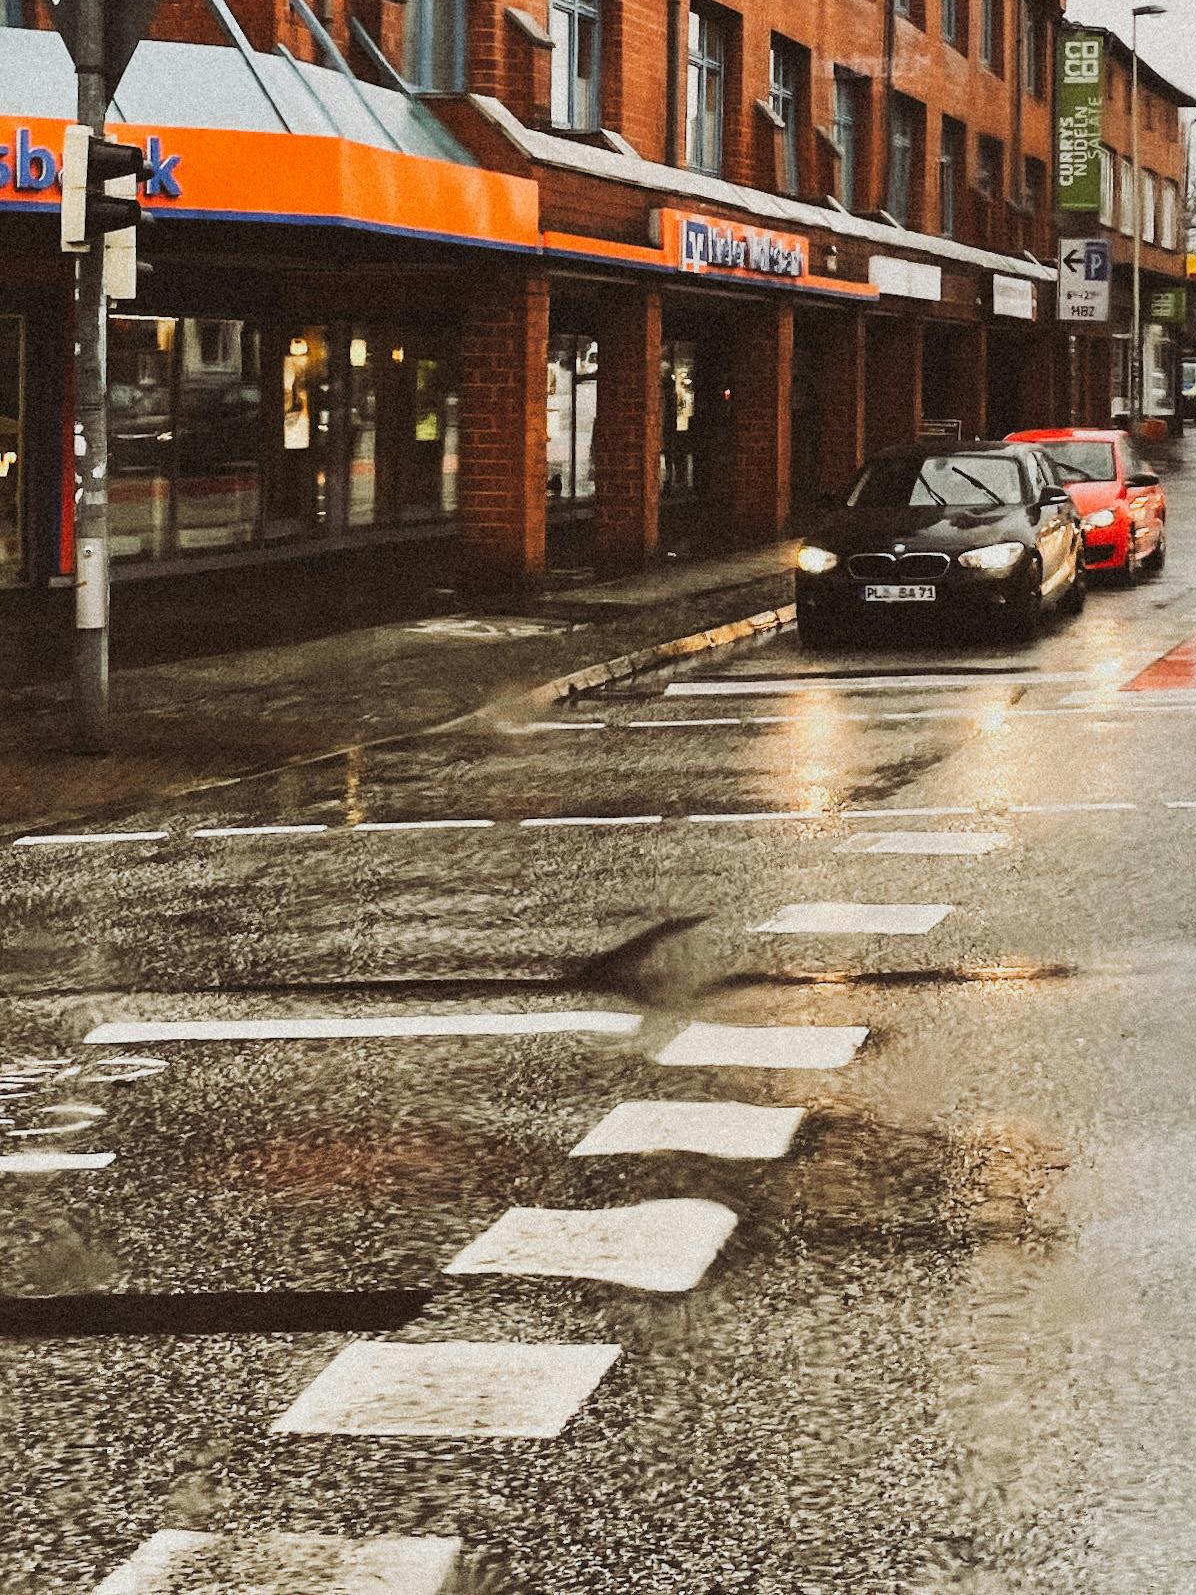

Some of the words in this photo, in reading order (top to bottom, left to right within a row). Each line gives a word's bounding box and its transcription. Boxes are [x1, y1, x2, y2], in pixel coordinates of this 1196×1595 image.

[1059, 116, 1075, 187] CURRYS
[1073, 105, 1089, 177] NUDELN
[1087, 96, 1103, 160] SALATE
